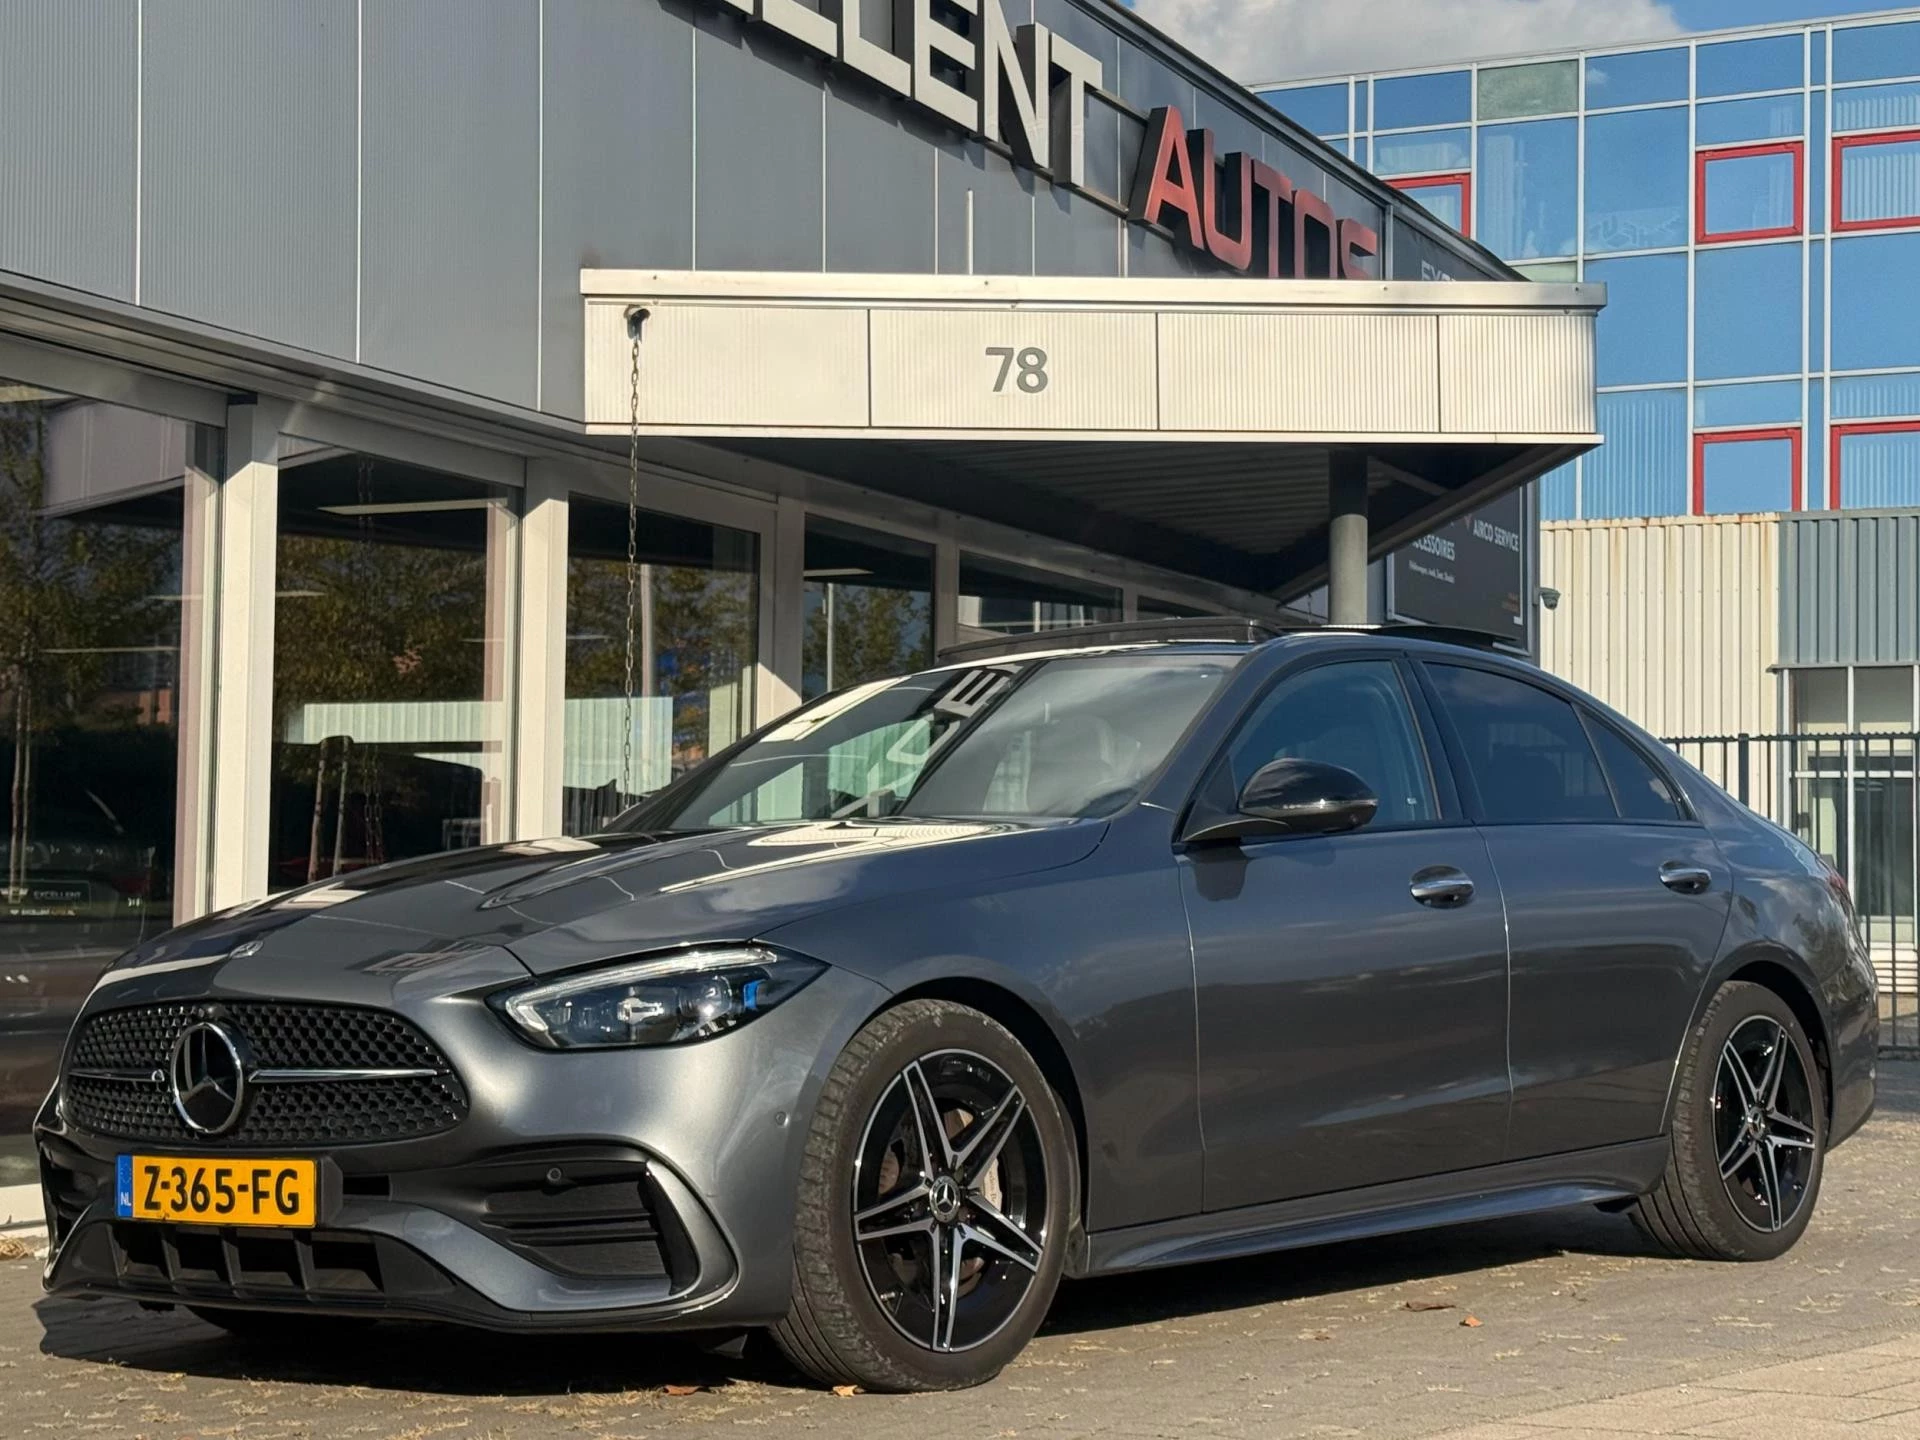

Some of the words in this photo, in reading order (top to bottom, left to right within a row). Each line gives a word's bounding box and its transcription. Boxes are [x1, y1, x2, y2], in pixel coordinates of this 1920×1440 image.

[985, 346, 1049, 394] 78
[1412, 534, 1456, 561] CESSOIRES
[1473, 519, 1494, 542] AIRCO
[1494, 526, 1519, 552] SERVICE
[120, 1191, 132, 1207] NL
[144, 1165, 300, 1215] Z-365-FG
